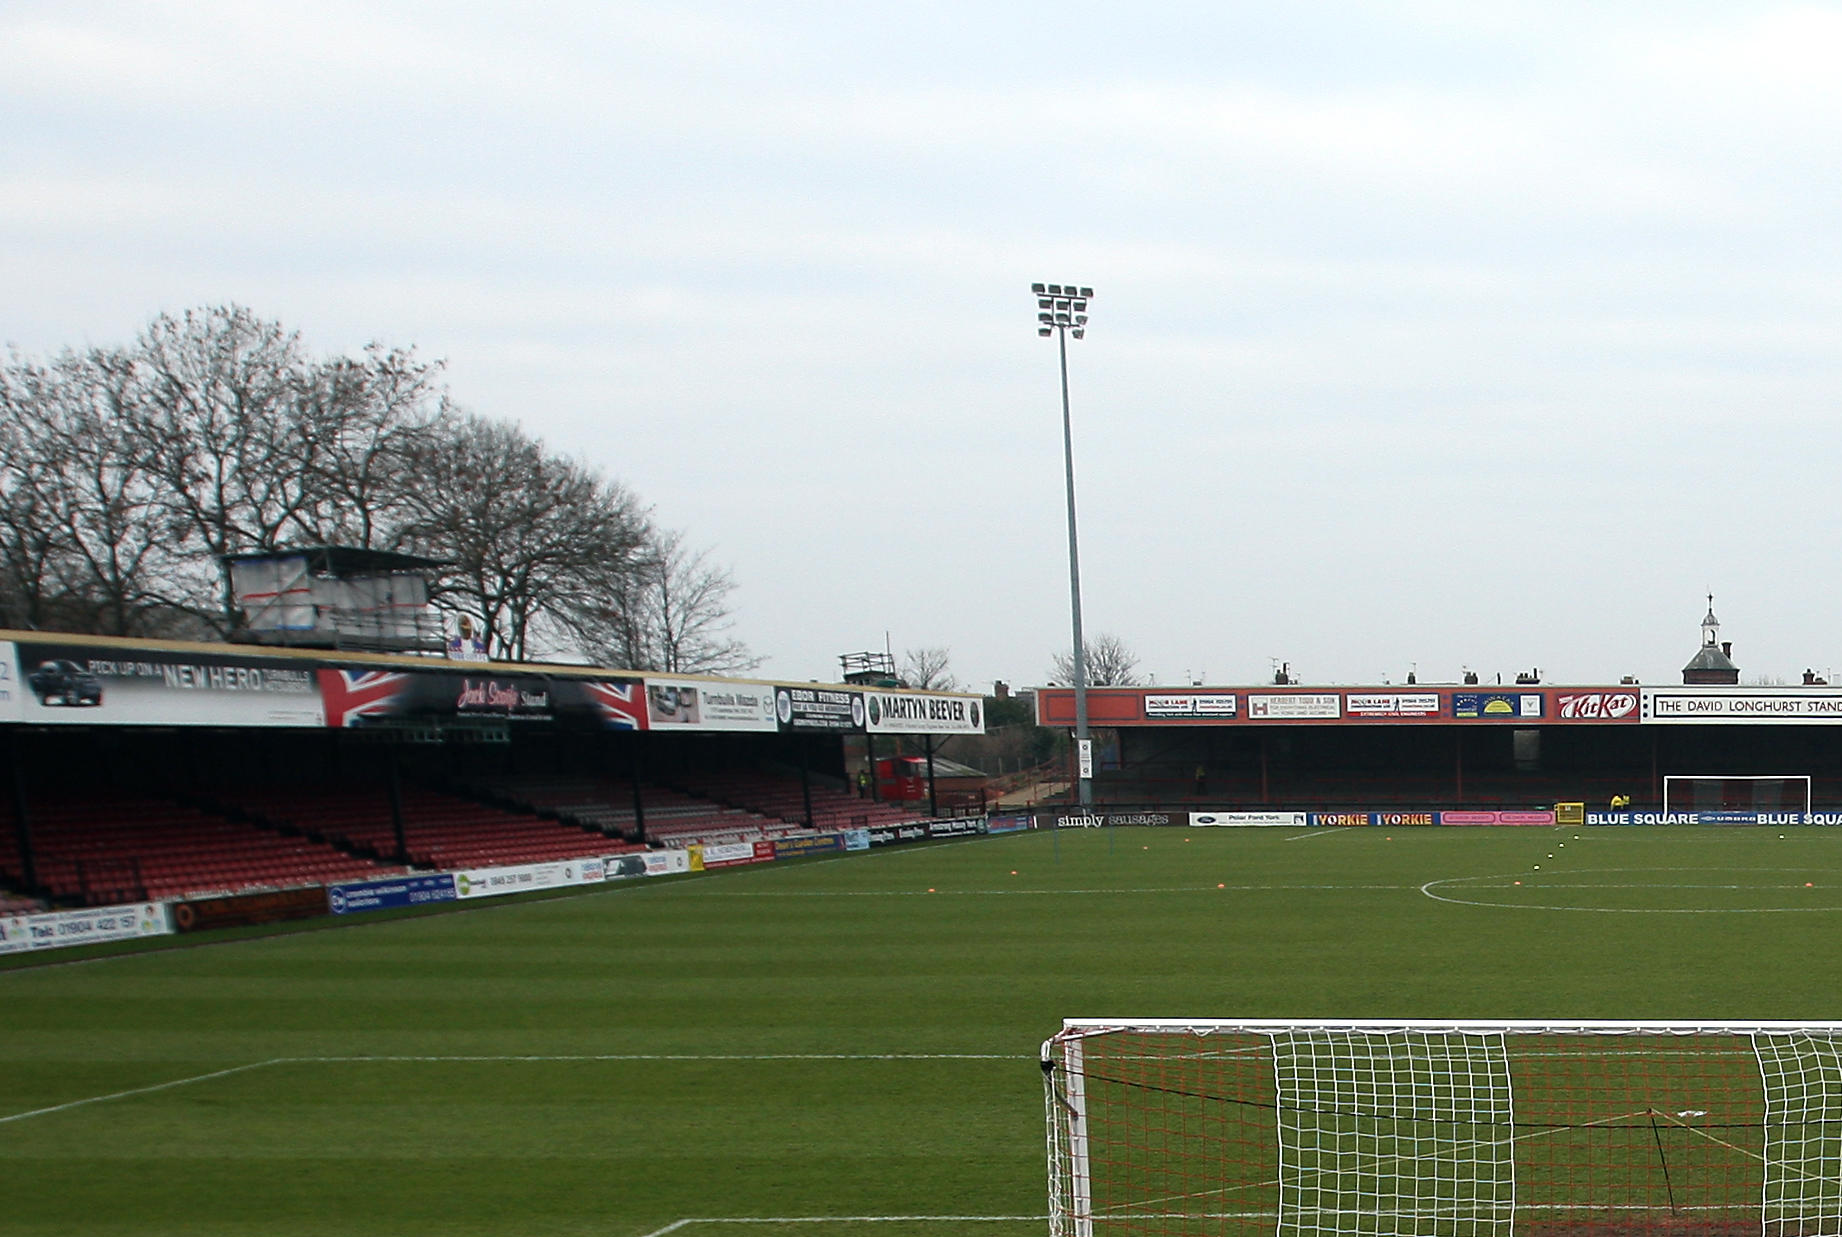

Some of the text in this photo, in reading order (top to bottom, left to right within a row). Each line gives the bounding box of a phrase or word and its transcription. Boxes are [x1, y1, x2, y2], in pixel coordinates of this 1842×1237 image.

[163, 664, 208, 689] NEW
[209, 667, 262, 690] HERO
[819, 692, 850, 705] FITNESS
[882, 697, 965, 721] MARTYN BEEVER
[1572, 694, 1628, 718] KitKat
[1658, 700, 1681, 712] THE
[1687, 700, 1722, 712] DAVID
[1729, 700, 1801, 712] LONGHURST
[1057, 814, 1168, 828] simply sausages
[1318, 813, 1369, 826] YORKIE
[1381, 813, 1432, 826] YORKIE
[1587, 813, 1699, 825] BLUE SQUARE
[1757, 814, 1798, 825] BLUE
